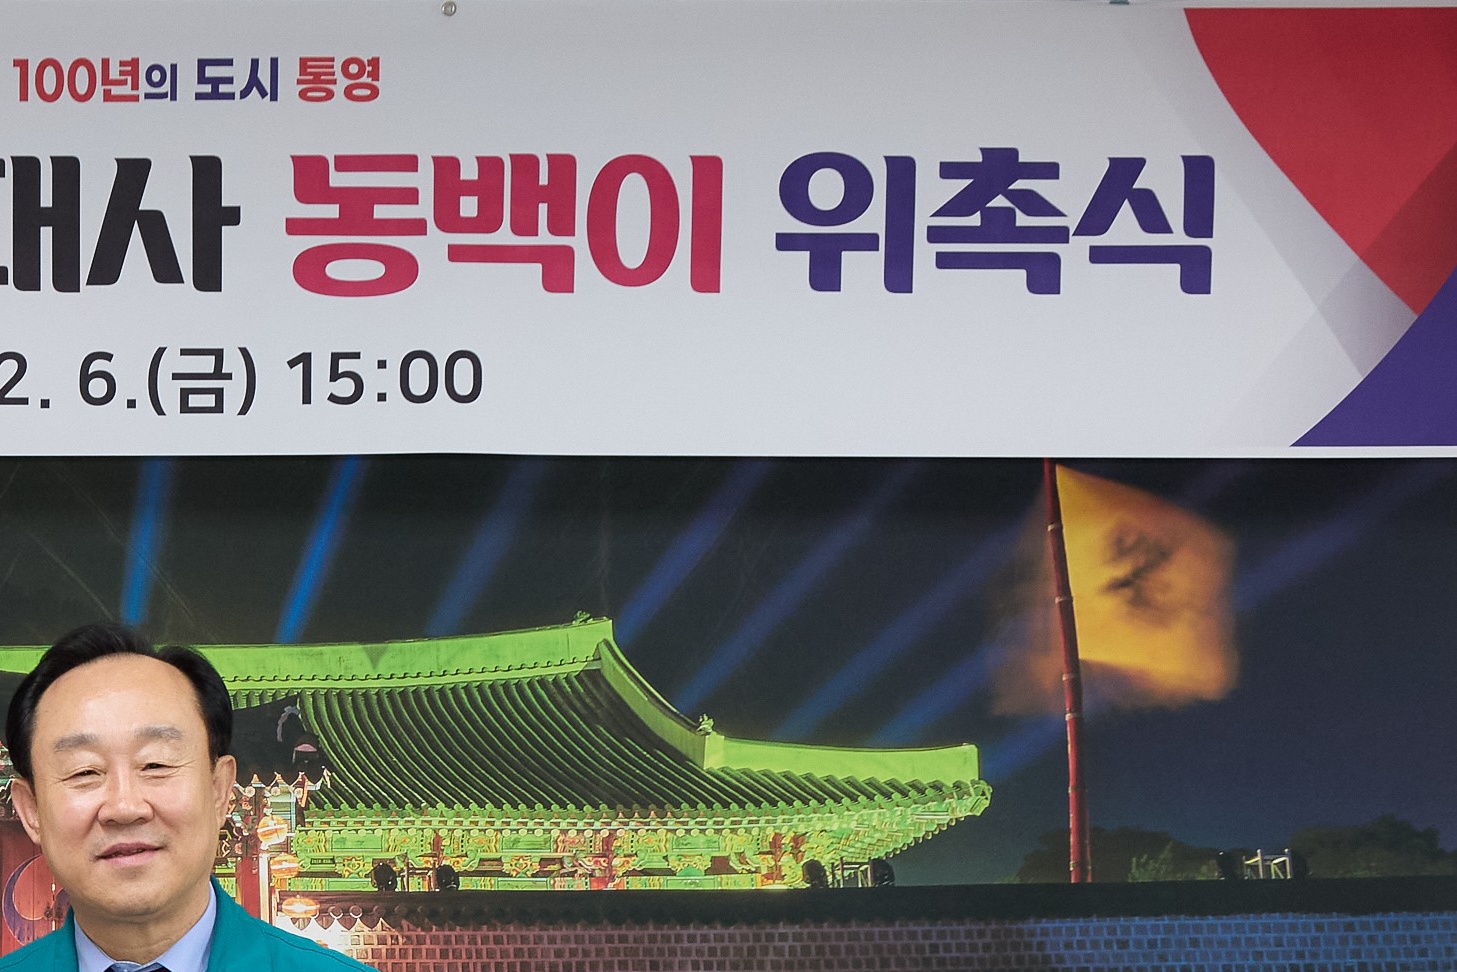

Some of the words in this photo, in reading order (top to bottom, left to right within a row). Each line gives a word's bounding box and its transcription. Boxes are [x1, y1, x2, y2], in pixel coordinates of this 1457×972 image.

[12, 57, 178, 104] 100년의
[194, 56, 279, 102] 도시
[296, 56, 381, 103] 통영
[285, 153, 724, 298] 동백이
[775, 147, 1216, 295] 위촉식
[79, 346, 257, 417] 6.(금)
[286, 349, 483, 406] 15:00
